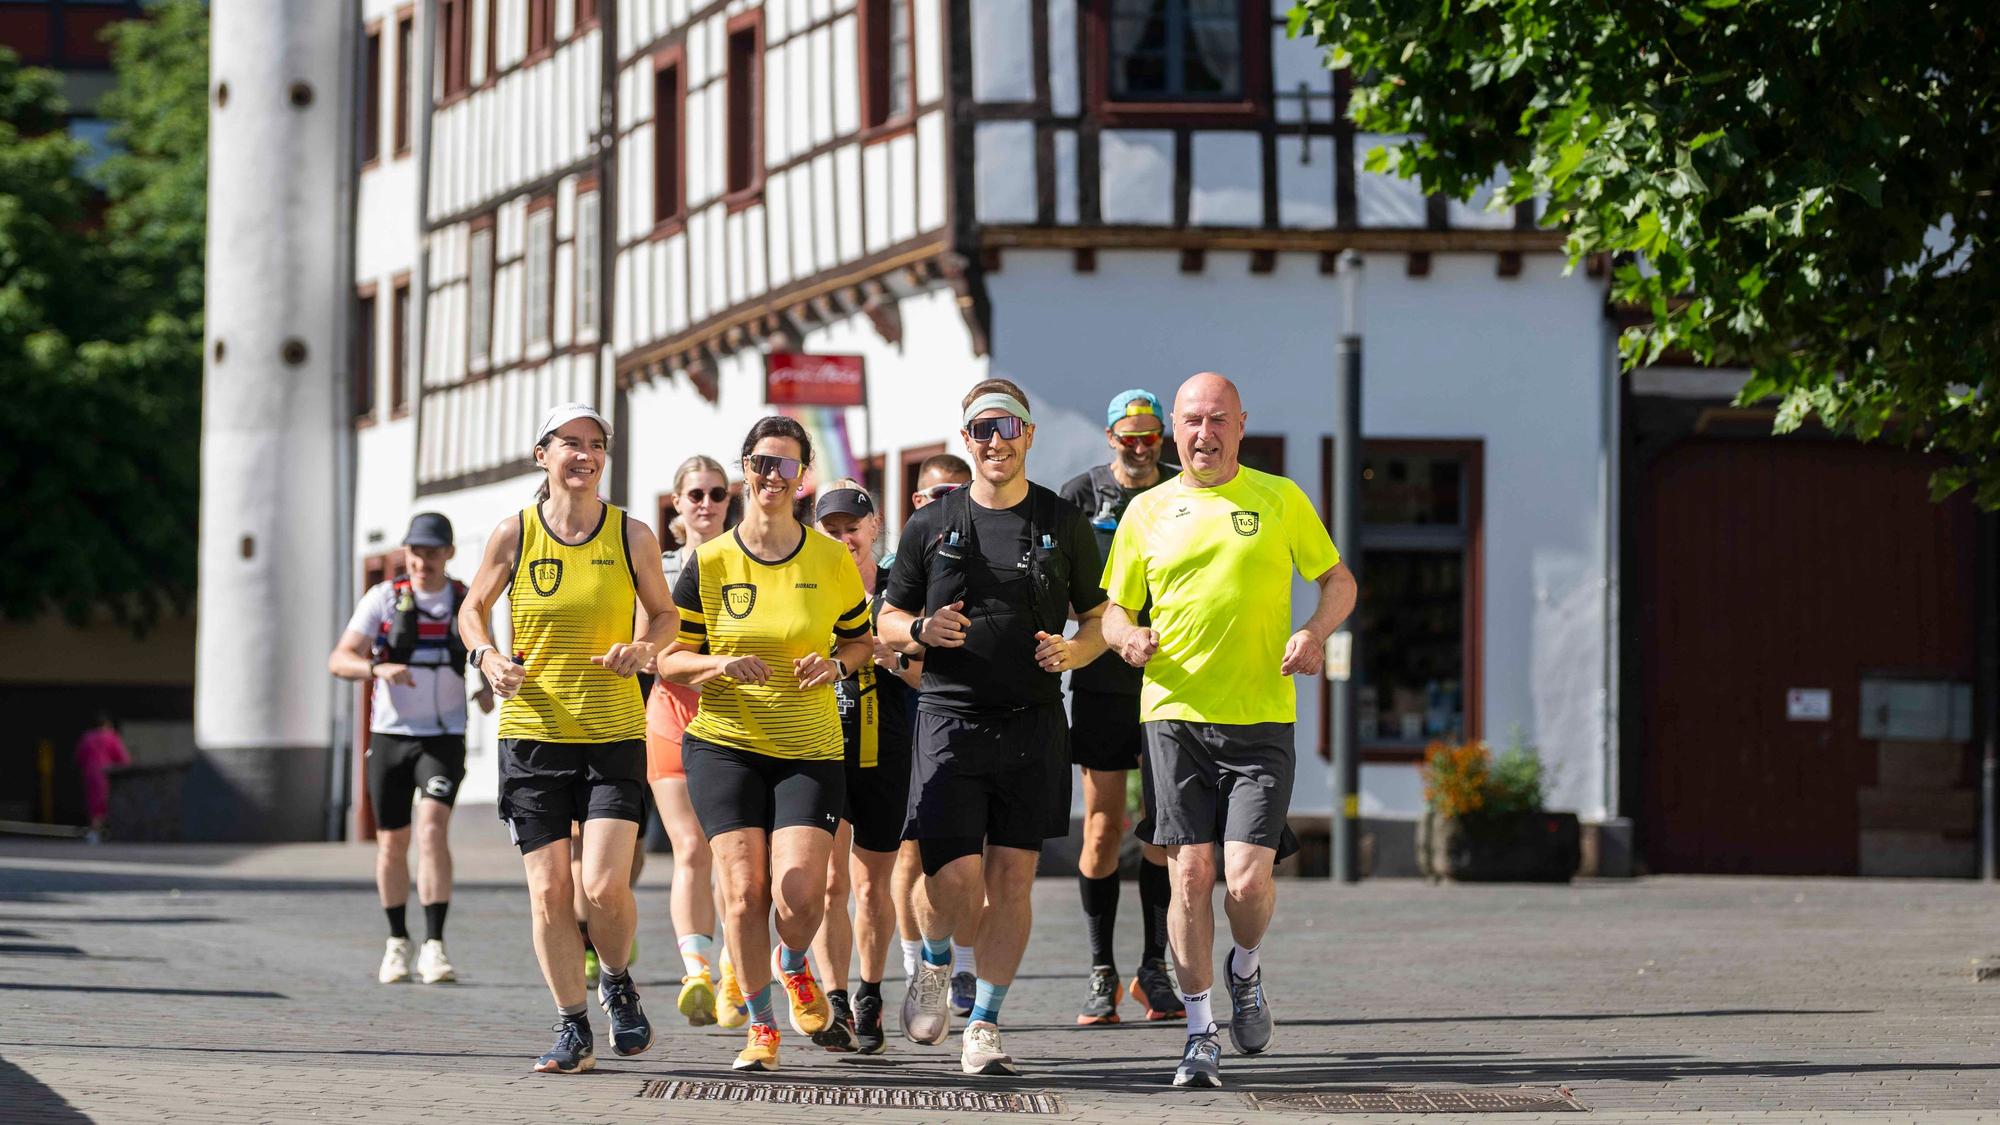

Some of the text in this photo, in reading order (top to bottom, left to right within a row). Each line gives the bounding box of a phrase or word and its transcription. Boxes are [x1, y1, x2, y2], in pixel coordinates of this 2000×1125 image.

[1238, 518, 1253, 527] TuS
[538, 568, 556, 580] TuS
[730, 592, 749, 604] TuS
